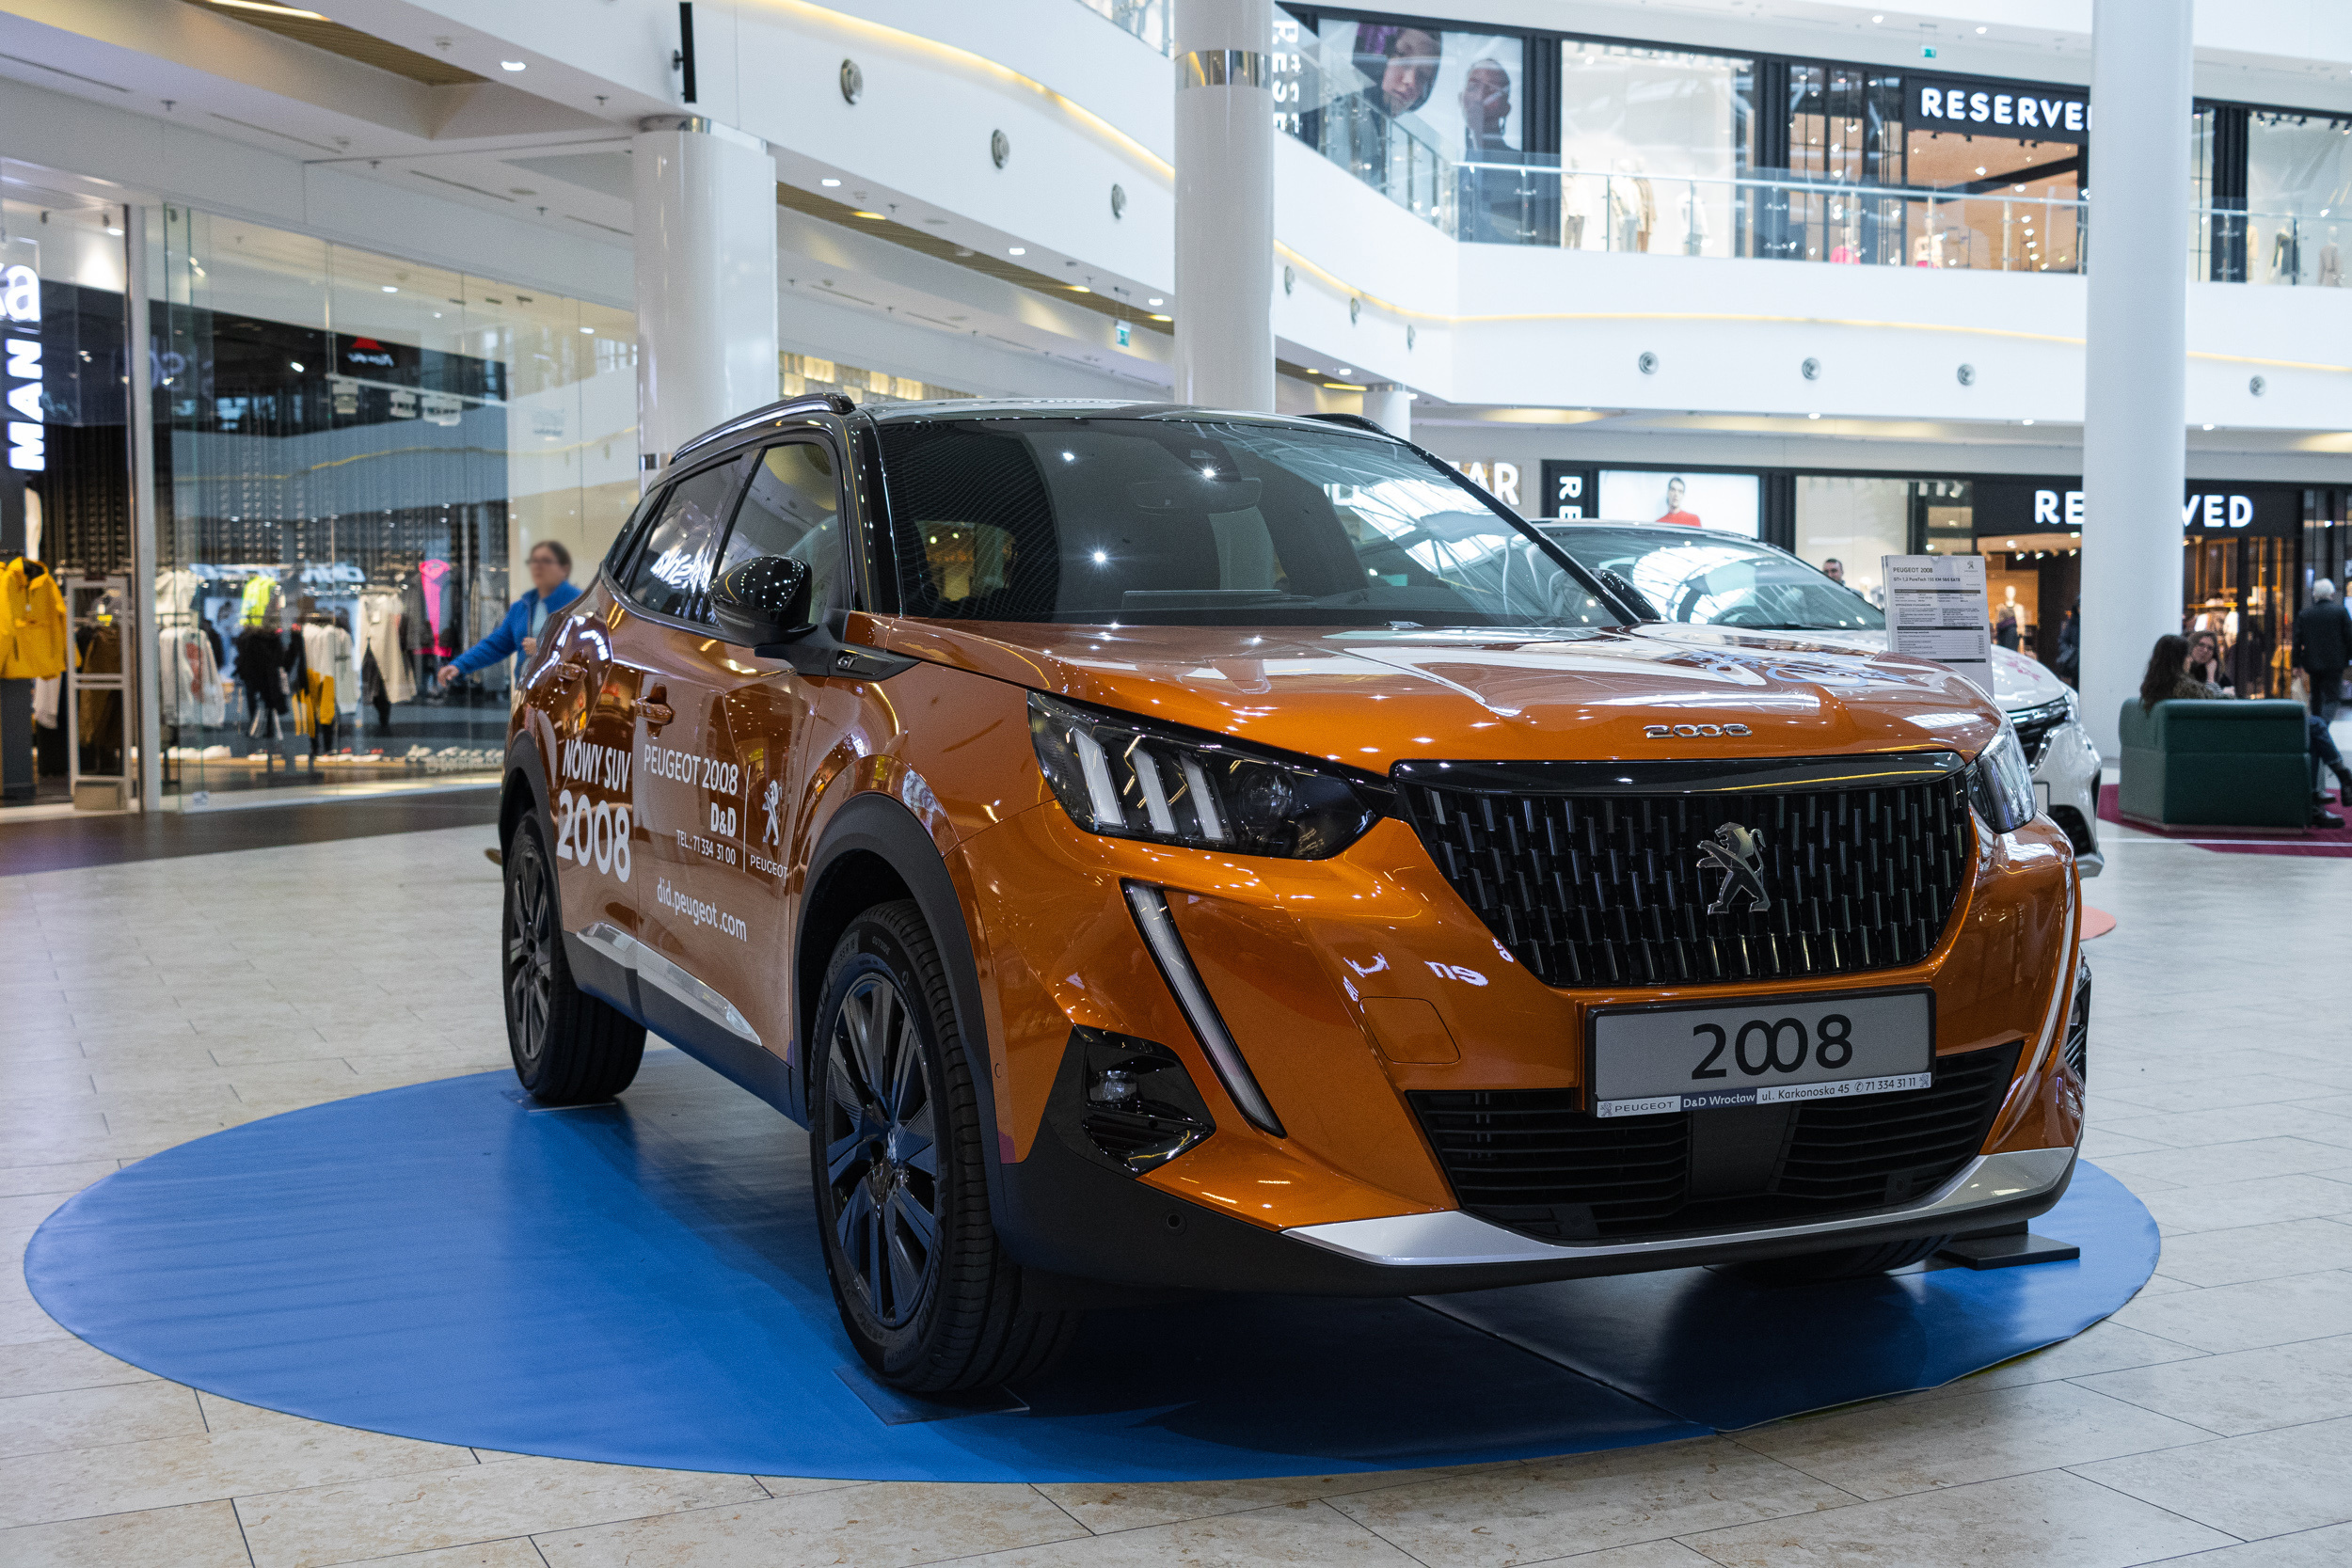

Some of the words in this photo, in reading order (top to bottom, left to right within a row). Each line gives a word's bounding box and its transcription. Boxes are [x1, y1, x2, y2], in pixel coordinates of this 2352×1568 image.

[1921, 87, 2092, 131] RESERVE
[5, 337, 45, 471] MAN
[1448, 460, 1520, 506] AR
[1643, 723, 1753, 738] 2008
[563, 738, 604, 785] NOWY
[604, 747, 631, 793] SUV
[644, 744, 701, 785] PEUGEOT
[702, 758, 739, 796] 2008
[557, 789, 631, 883] 2008
[710, 802, 737, 837] D&D
[693, 835, 700, 853] 71
[701, 838, 714, 857] 334
[717, 844, 724, 862] 31
[725, 847, 737, 865] 00
[750, 854, 788, 879] PEUGEOT
[657, 877, 747, 942] did.peugeot.com
[1692, 1014, 1852, 1080] 2008
[1614, 1101, 1674, 1113] PEUGEOT
[1683, 1097, 1707, 1108] D&D
[1709, 1093, 1756, 1105] Wrocław
[1761, 1090, 1774, 1101] ul.
[1778, 1085, 1836, 1100] Karkonoska
[1837, 1084, 1850, 1094] 45
[1866, 1081, 1875, 1091] 71
[1877, 1079, 1895, 1090] 334
[1897, 1078, 1906, 1088] 31
[1909, 1077, 1916, 1087] 11
